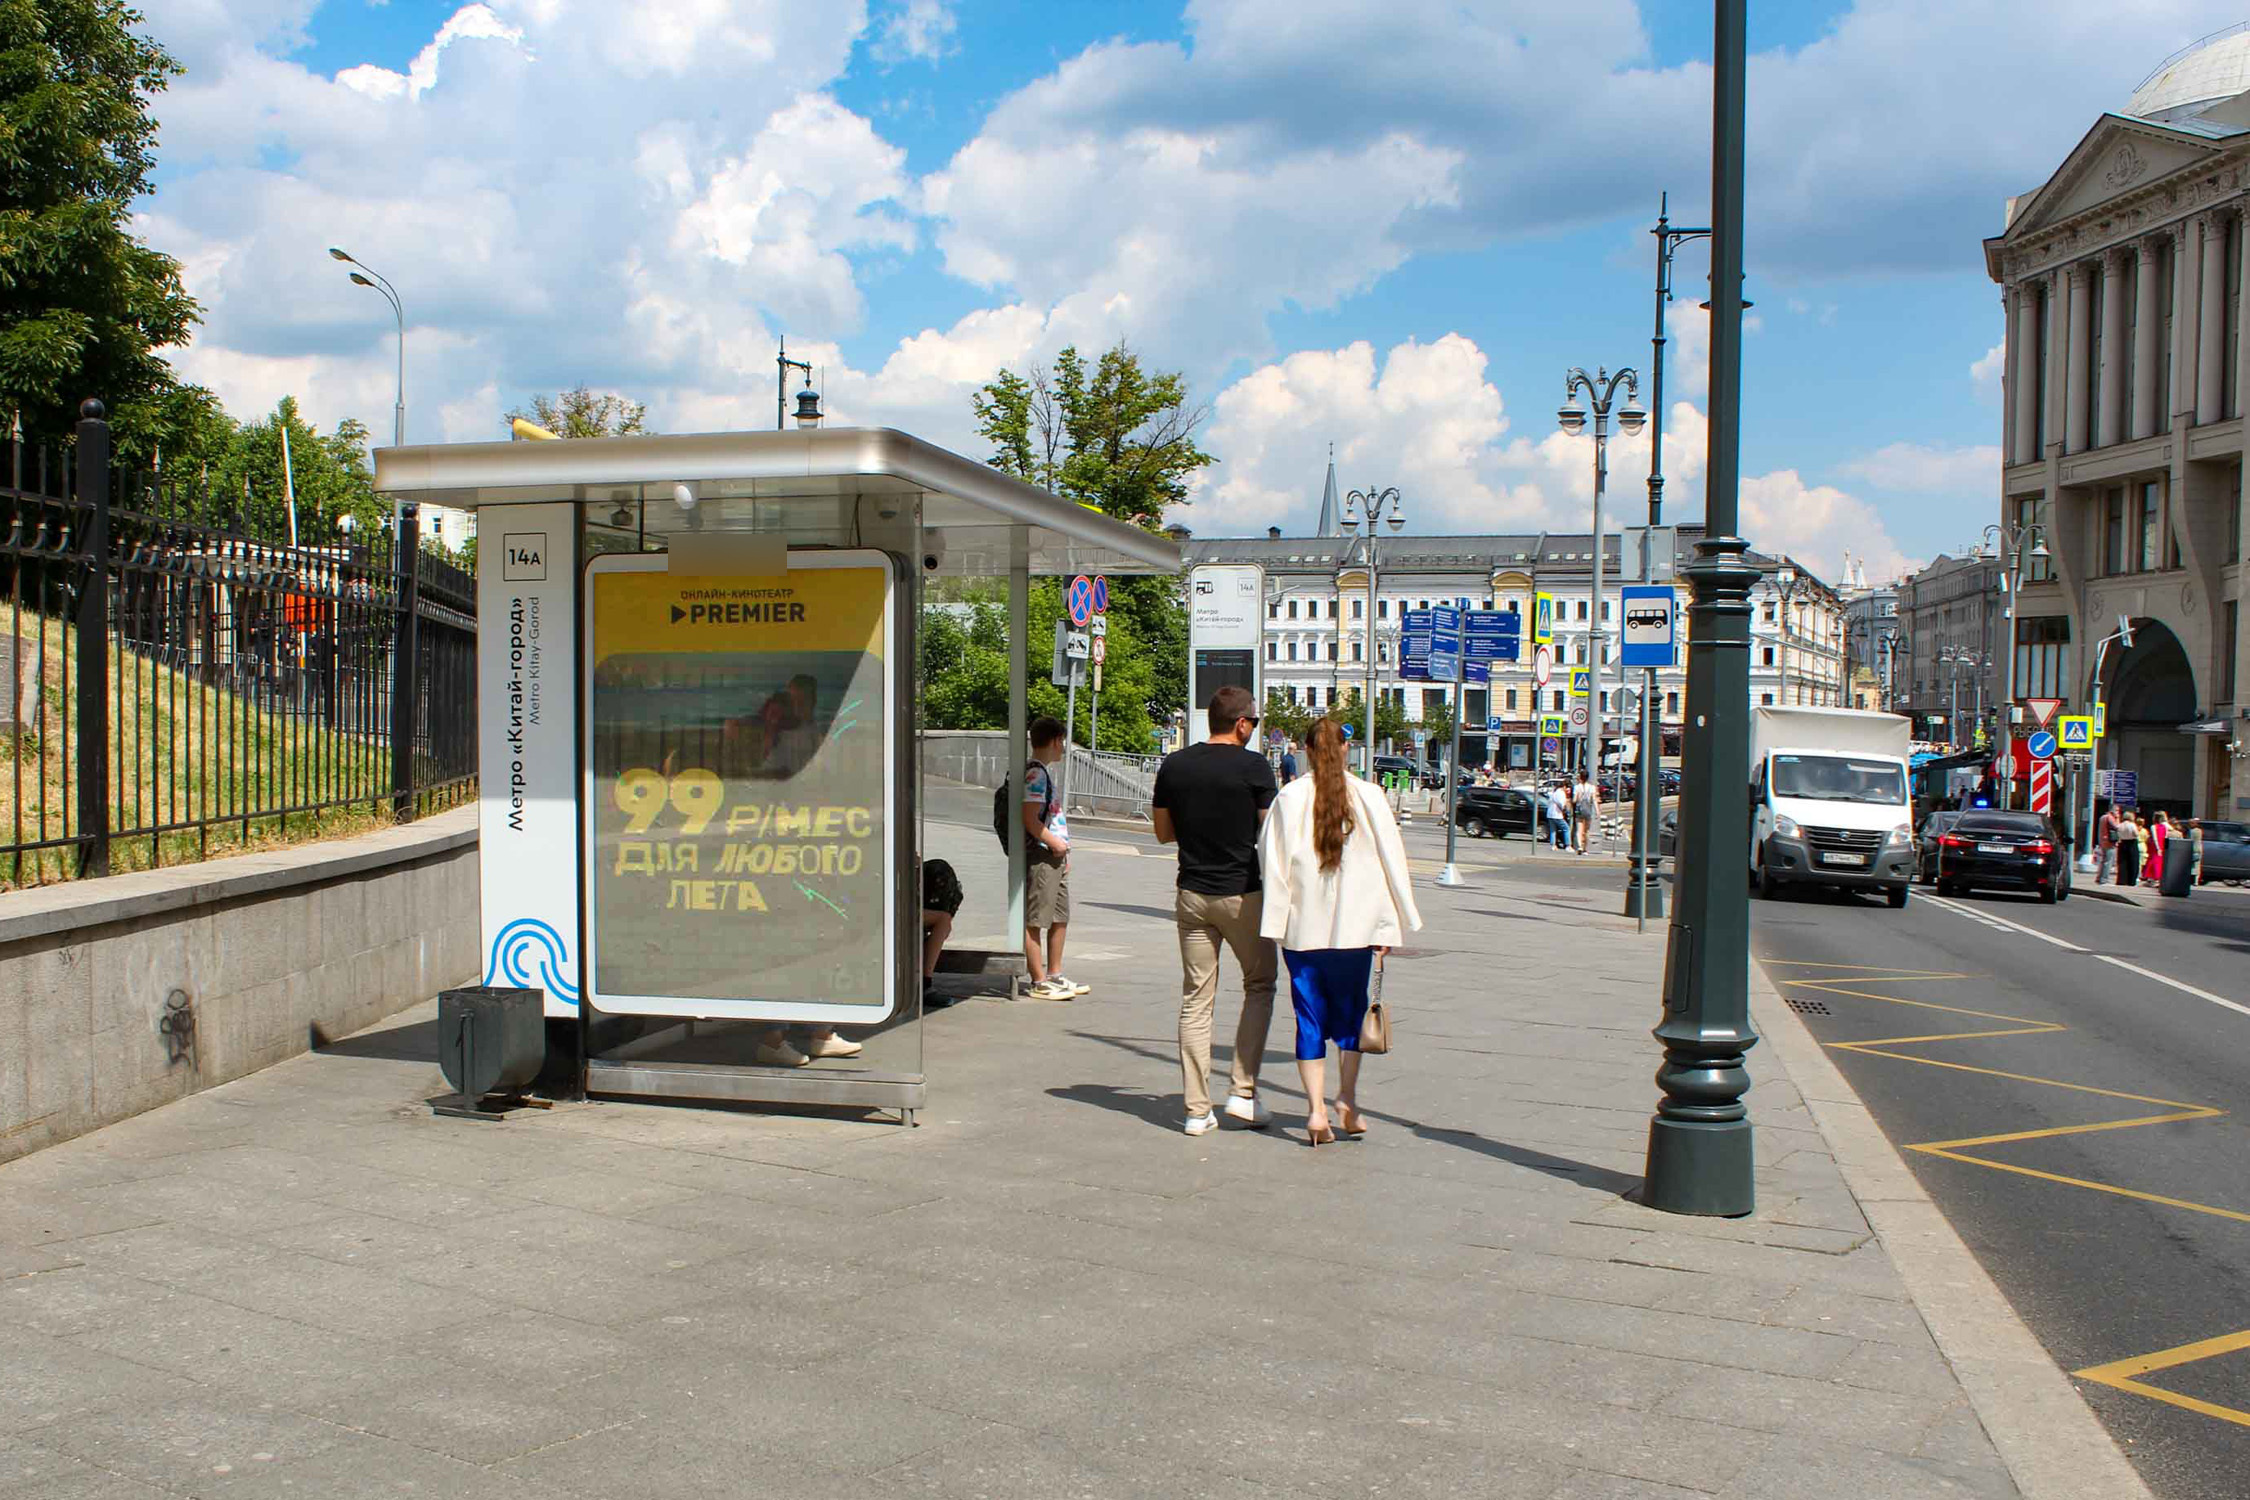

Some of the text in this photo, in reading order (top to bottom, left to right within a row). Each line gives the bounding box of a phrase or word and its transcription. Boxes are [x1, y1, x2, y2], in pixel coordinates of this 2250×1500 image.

[509, 549, 541, 565] 14А
[680, 588, 795, 600] ОНЛАЙН-КИНОТЕАТР
[690, 602, 805, 624] PREMIER
[529, 597, 542, 725] Metro Kitay-Gorod
[508, 598, 526, 831] Метро «Китай-город»
[614, 768, 724, 835] 99
[615, 841, 863, 877] ДЛЯ ЛЮБОГО
[667, 879, 770, 913] ЛЕТА
